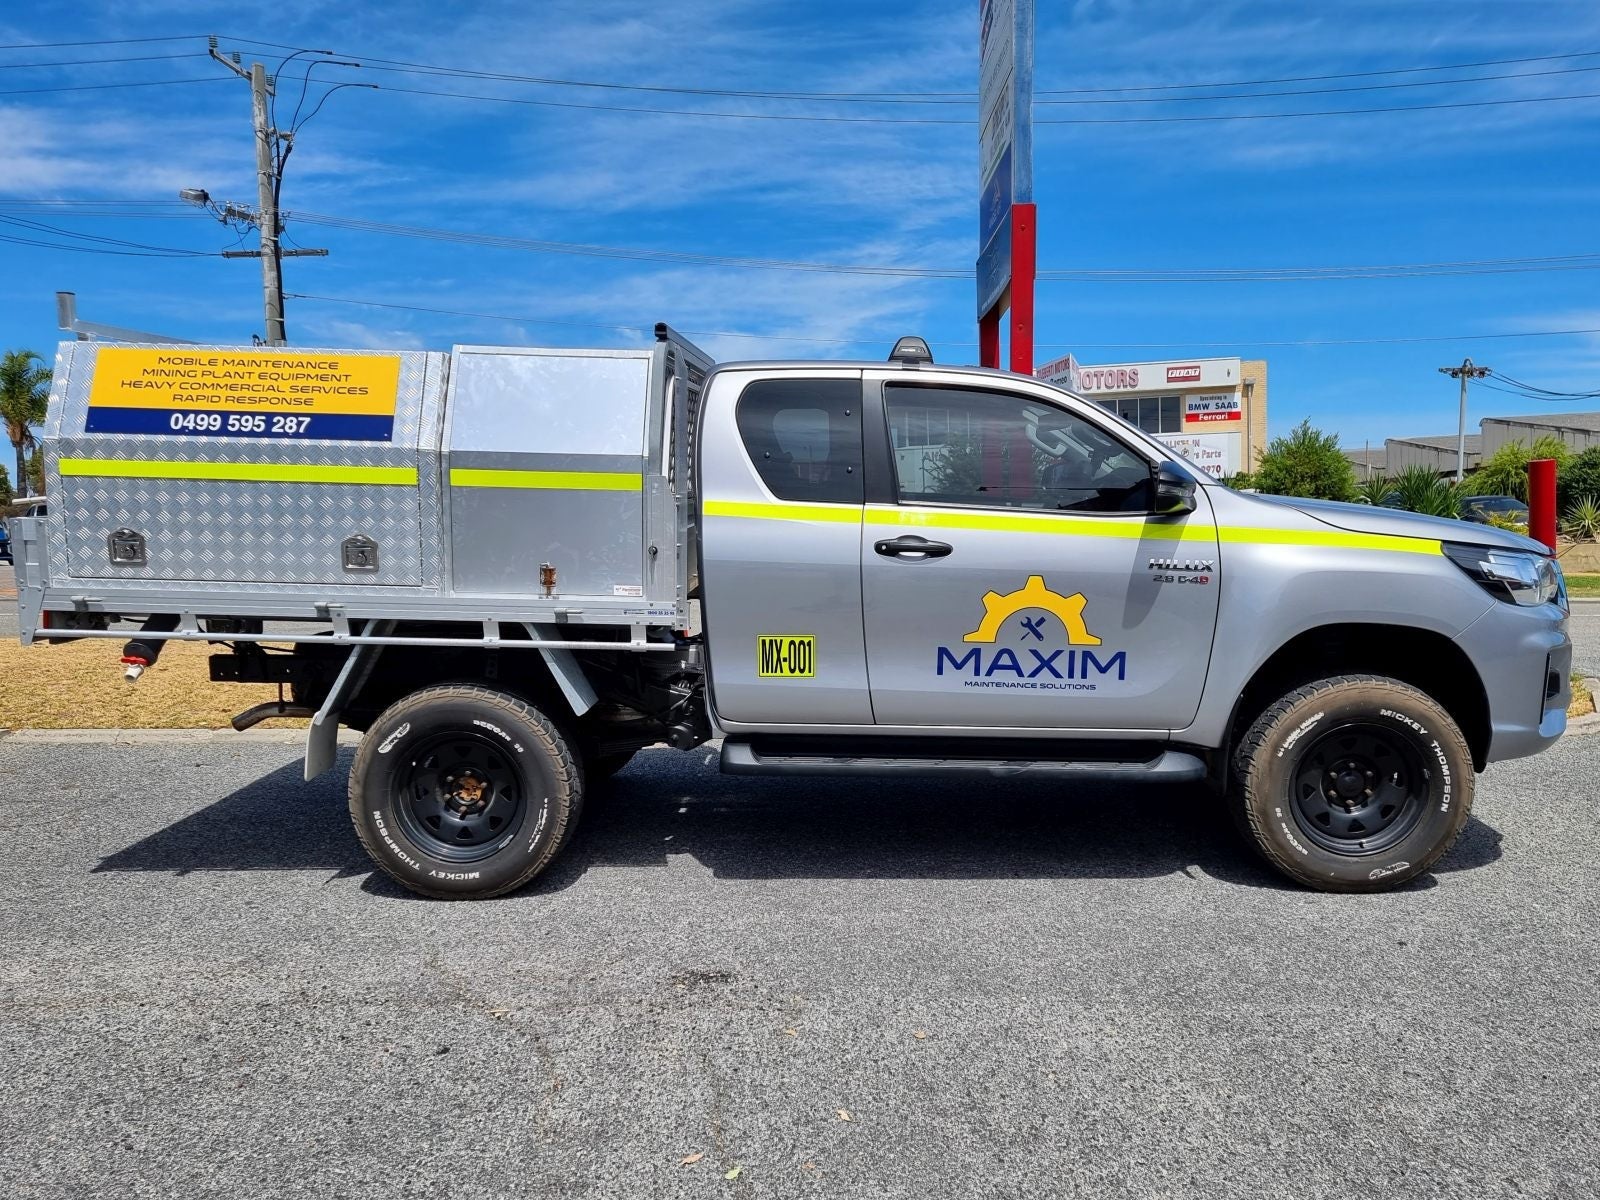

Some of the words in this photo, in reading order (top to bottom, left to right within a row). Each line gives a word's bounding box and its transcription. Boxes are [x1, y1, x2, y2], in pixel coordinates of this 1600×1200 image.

[158, 356, 218, 367] MOBILE
[222, 358, 339, 370] MAINTENANCE
[142, 368, 198, 378] MINING
[201, 370, 256, 380] PLANT
[258, 372, 352, 383] EQUIPMENT
[1168, 368, 1200, 378] FIAT
[121, 380, 176, 390] HEAVY
[179, 382, 286, 394] COMMERCIAL
[288, 385, 368, 395] SERVICES
[172, 394, 222, 404] RAPID
[224, 395, 314, 406] RESPONSE
[1215, 402, 1238, 410] SAAB
[170, 413, 222, 431] 0499
[227, 414, 266, 432] 595
[271, 416, 311, 434] 287
[1202, 450, 1222, 458] Parts
[1149, 559, 1214, 572] HILUX
[761, 638, 812, 674] MX-001
[936, 646, 1126, 680] MAXIM
[964, 681, 1038, 690] MAINTENANCE
[1040, 682, 1096, 690] SOLUTIONS
[1380, 708, 1428, 736] MICKEY
[1430, 740, 1451, 813] THOMPSON
[372, 810, 420, 872] THOMPSON
[428, 870, 480, 881] MICKEY
